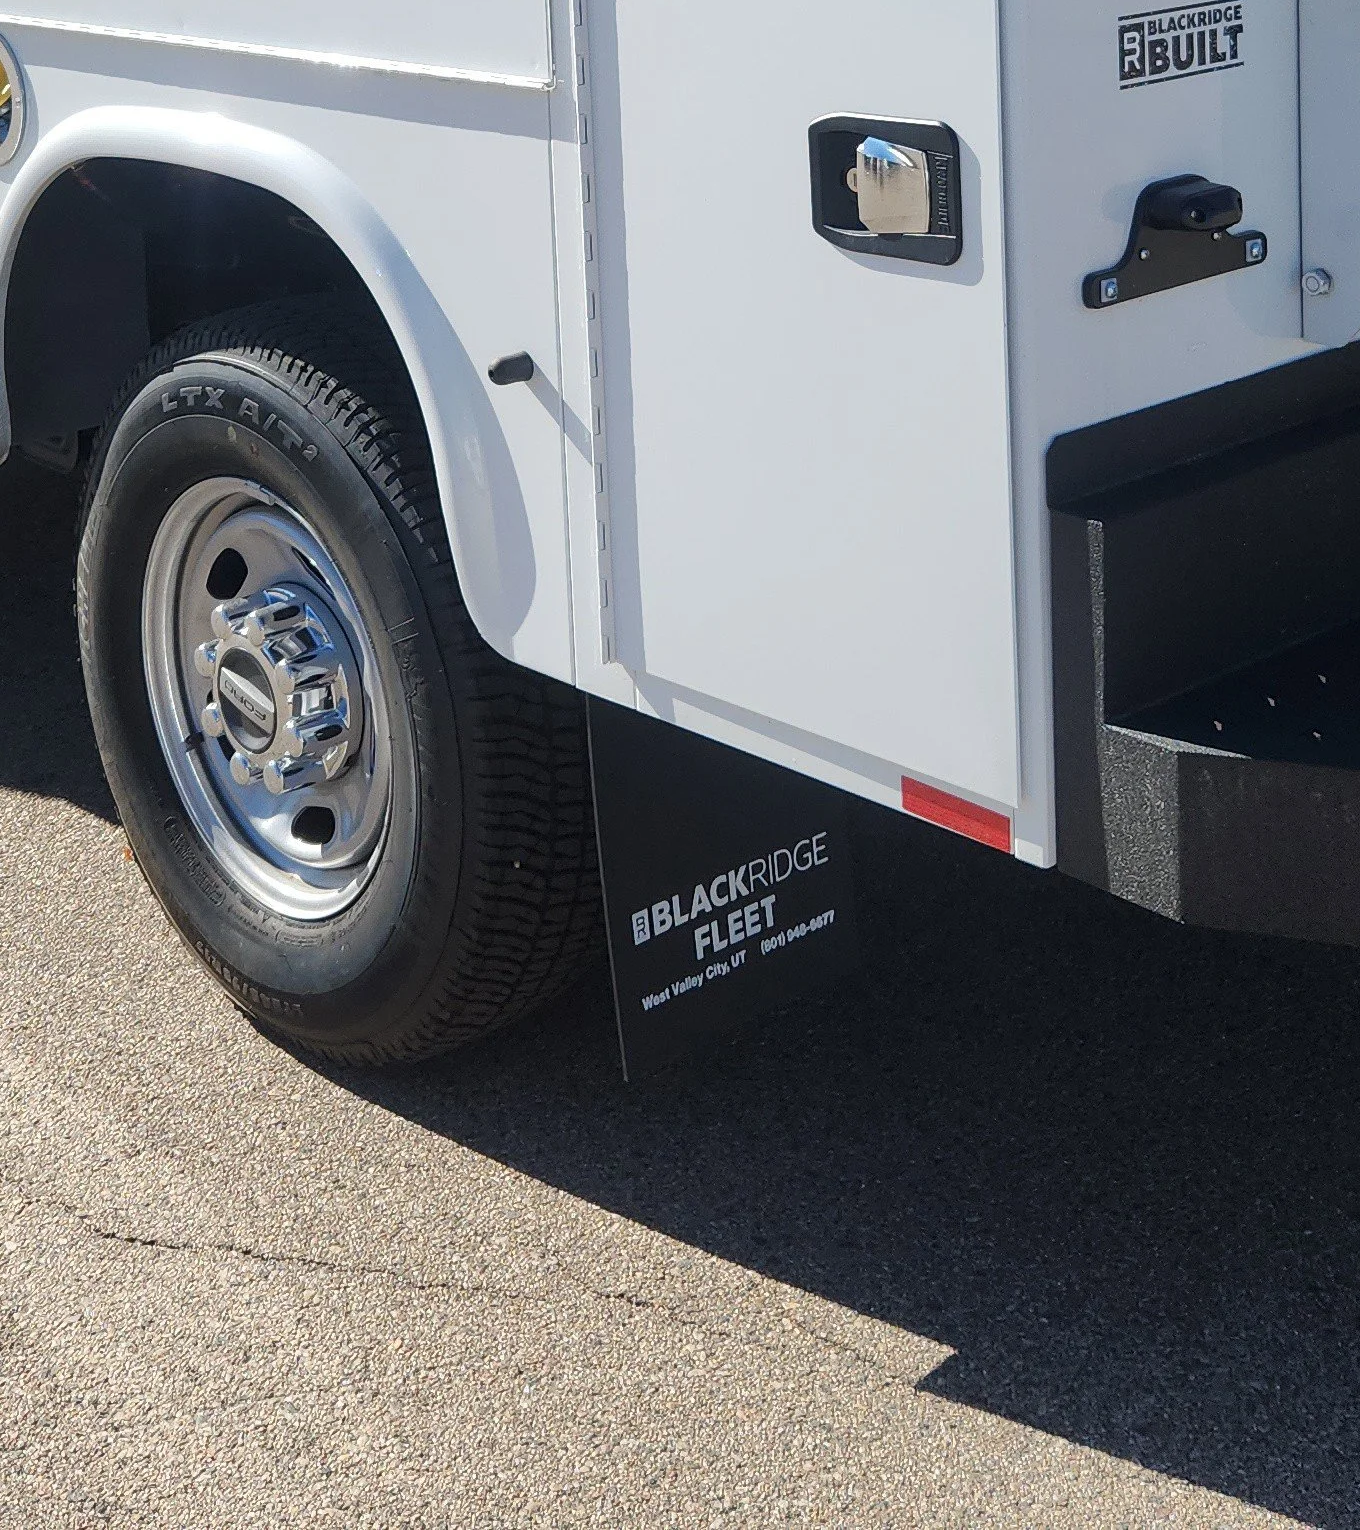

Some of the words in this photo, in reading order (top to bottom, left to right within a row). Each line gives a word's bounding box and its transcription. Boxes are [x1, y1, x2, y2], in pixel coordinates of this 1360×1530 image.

[1147, 4, 1243, 36] BLACKRIDGE
[1148, 24, 1244, 76] BUILT
[161, 386, 225, 413] LTX
[224, 680, 267, 721] FORD
[651, 831, 829, 936] BLACKRIDGE
[694, 894, 776, 960] FLEET
[642, 987, 671, 1011] West
[671, 972, 704, 996] Valley
[705, 961, 730, 980] City,
[730, 949, 747, 968] UT
[761, 931, 786, 956] (801)
